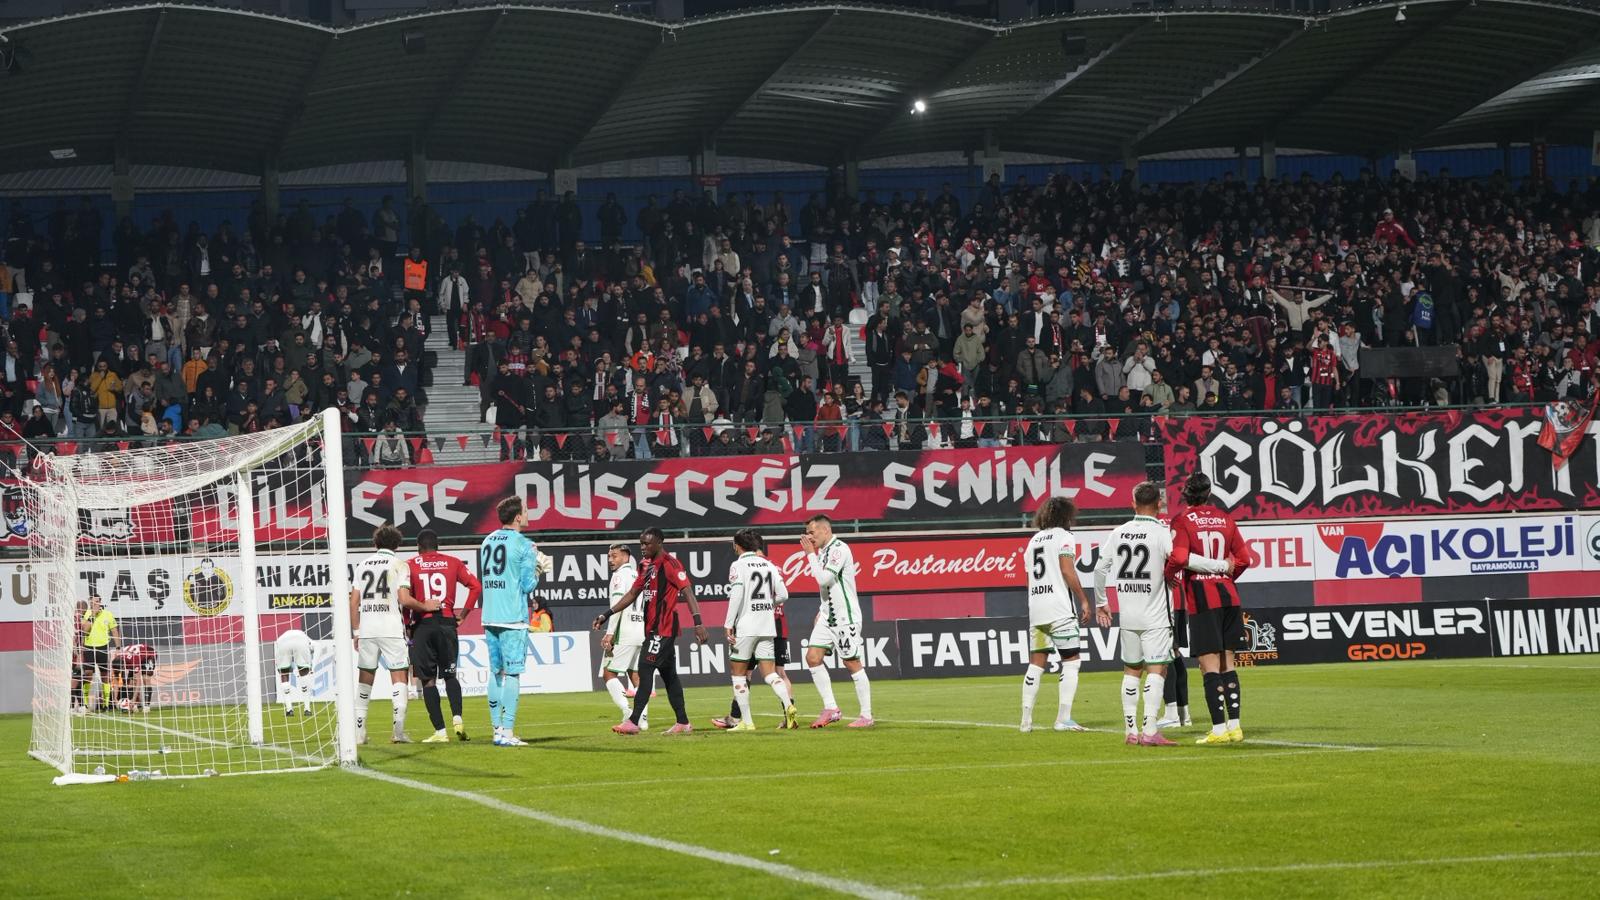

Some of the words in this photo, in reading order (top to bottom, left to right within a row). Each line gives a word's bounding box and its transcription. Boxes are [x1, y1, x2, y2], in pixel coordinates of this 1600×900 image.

[514, 455, 840, 528] DÜŞECEĞİZ
[883, 450, 1116, 510] SENİNLE
[483, 544, 506, 576] 29
[1197, 531, 1225, 560] 10
[1246, 537, 1312, 568] STEL
[1321, 526, 1344, 536] VAN
[1335, 534, 1426, 578] AÇI
[1431, 517, 1574, 560] KOLEJİ
[256, 566, 281, 588] AN
[289, 564, 330, 587] KAH
[873, 549, 1016, 577] Pastaneleri
[1033, 547, 1046, 580] 5
[1117, 543, 1151, 580] 22
[1472, 561, 1522, 571] BAYRAMOĞLU
[0, 565, 171, 611] ÜTAŞ
[361, 570, 390, 600] 24
[418, 573, 447, 602] 19
[695, 584, 731, 598] PARÇ
[750, 571, 773, 600] 21
[1282, 607, 1486, 641] SEVENLER
[1494, 609, 1549, 656] VAN
[648, 640, 660, 654] 13
[1239, 652, 1278, 660] SEVEN'S
[1347, 643, 1426, 661] GROUP
